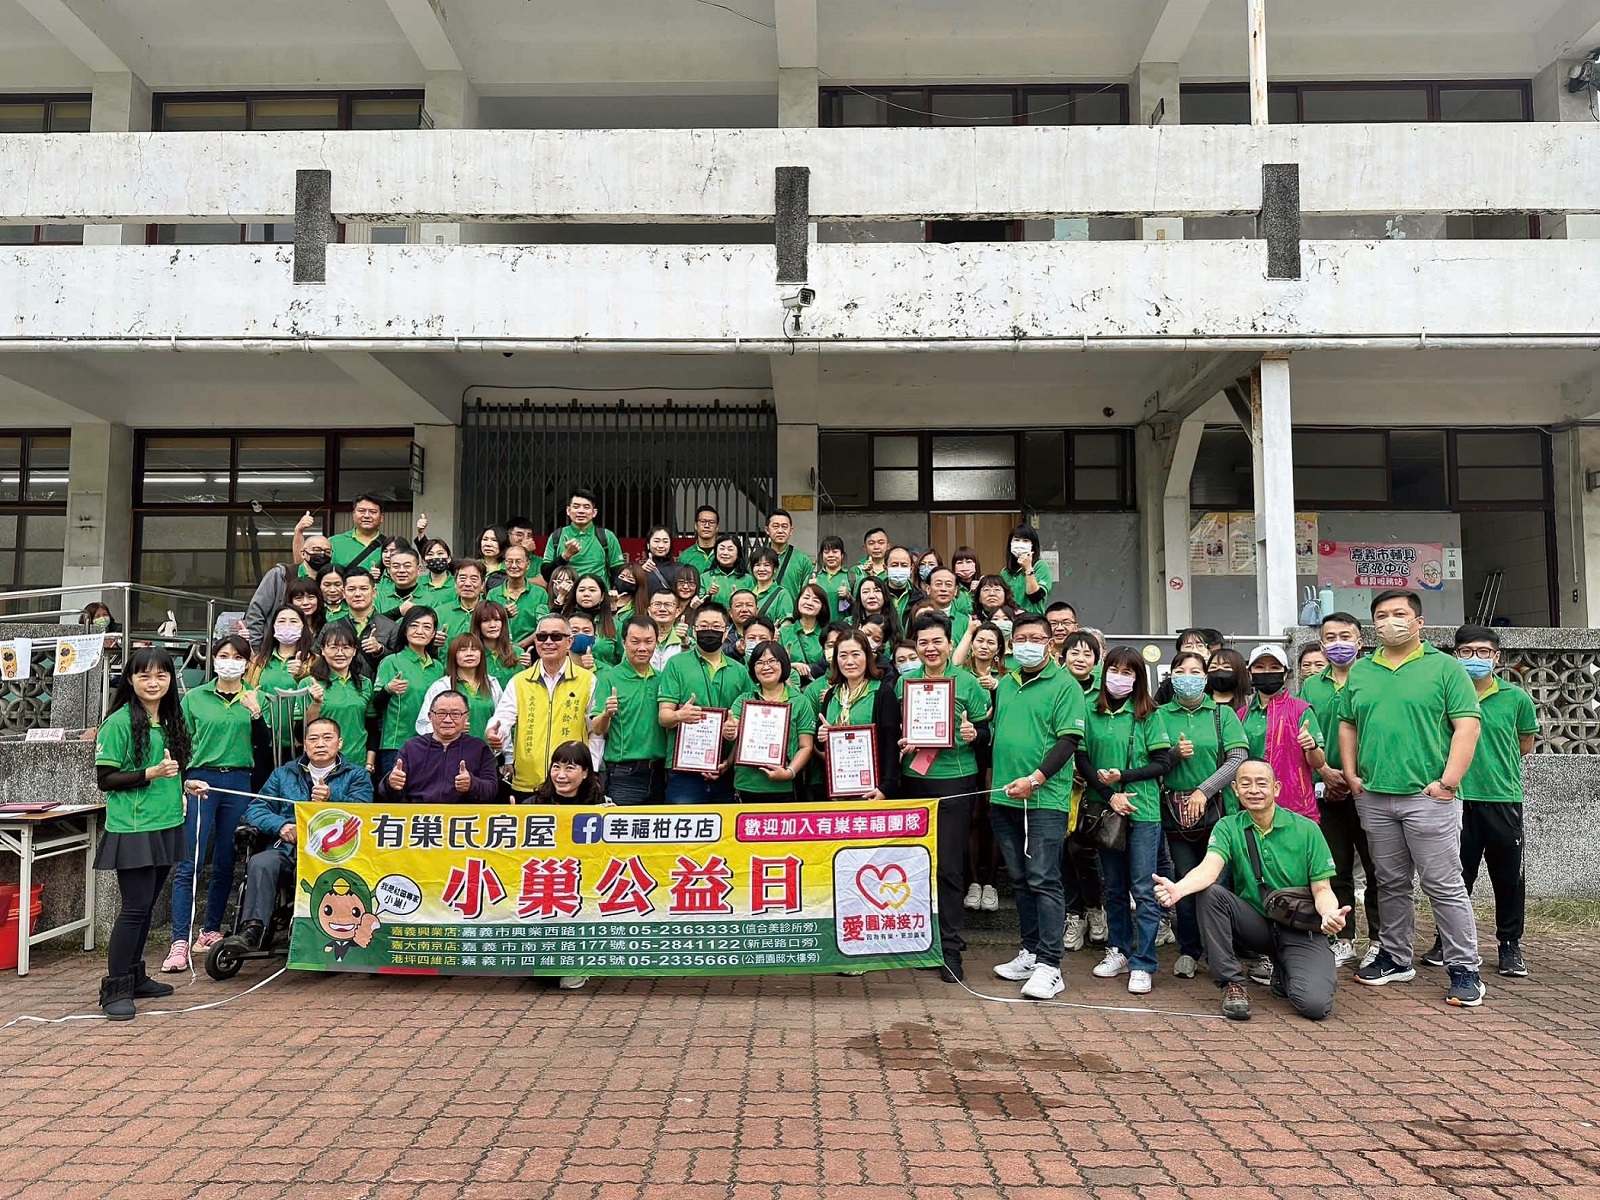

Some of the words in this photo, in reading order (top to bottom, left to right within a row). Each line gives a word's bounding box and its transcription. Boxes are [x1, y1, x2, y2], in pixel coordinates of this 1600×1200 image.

[1350, 547, 1417, 562] 嘉義市輔具
[1357, 562, 1410, 577] 資源中心
[370, 814, 556, 849] 有巢氏房屋
[609, 817, 715, 839] 幸福柑仔店
[744, 813, 921, 837] 歡迎加入有巢幸福團隊
[380, 882, 421, 903] 我是社區專家
[442, 855, 803, 919] 小巢公益日
